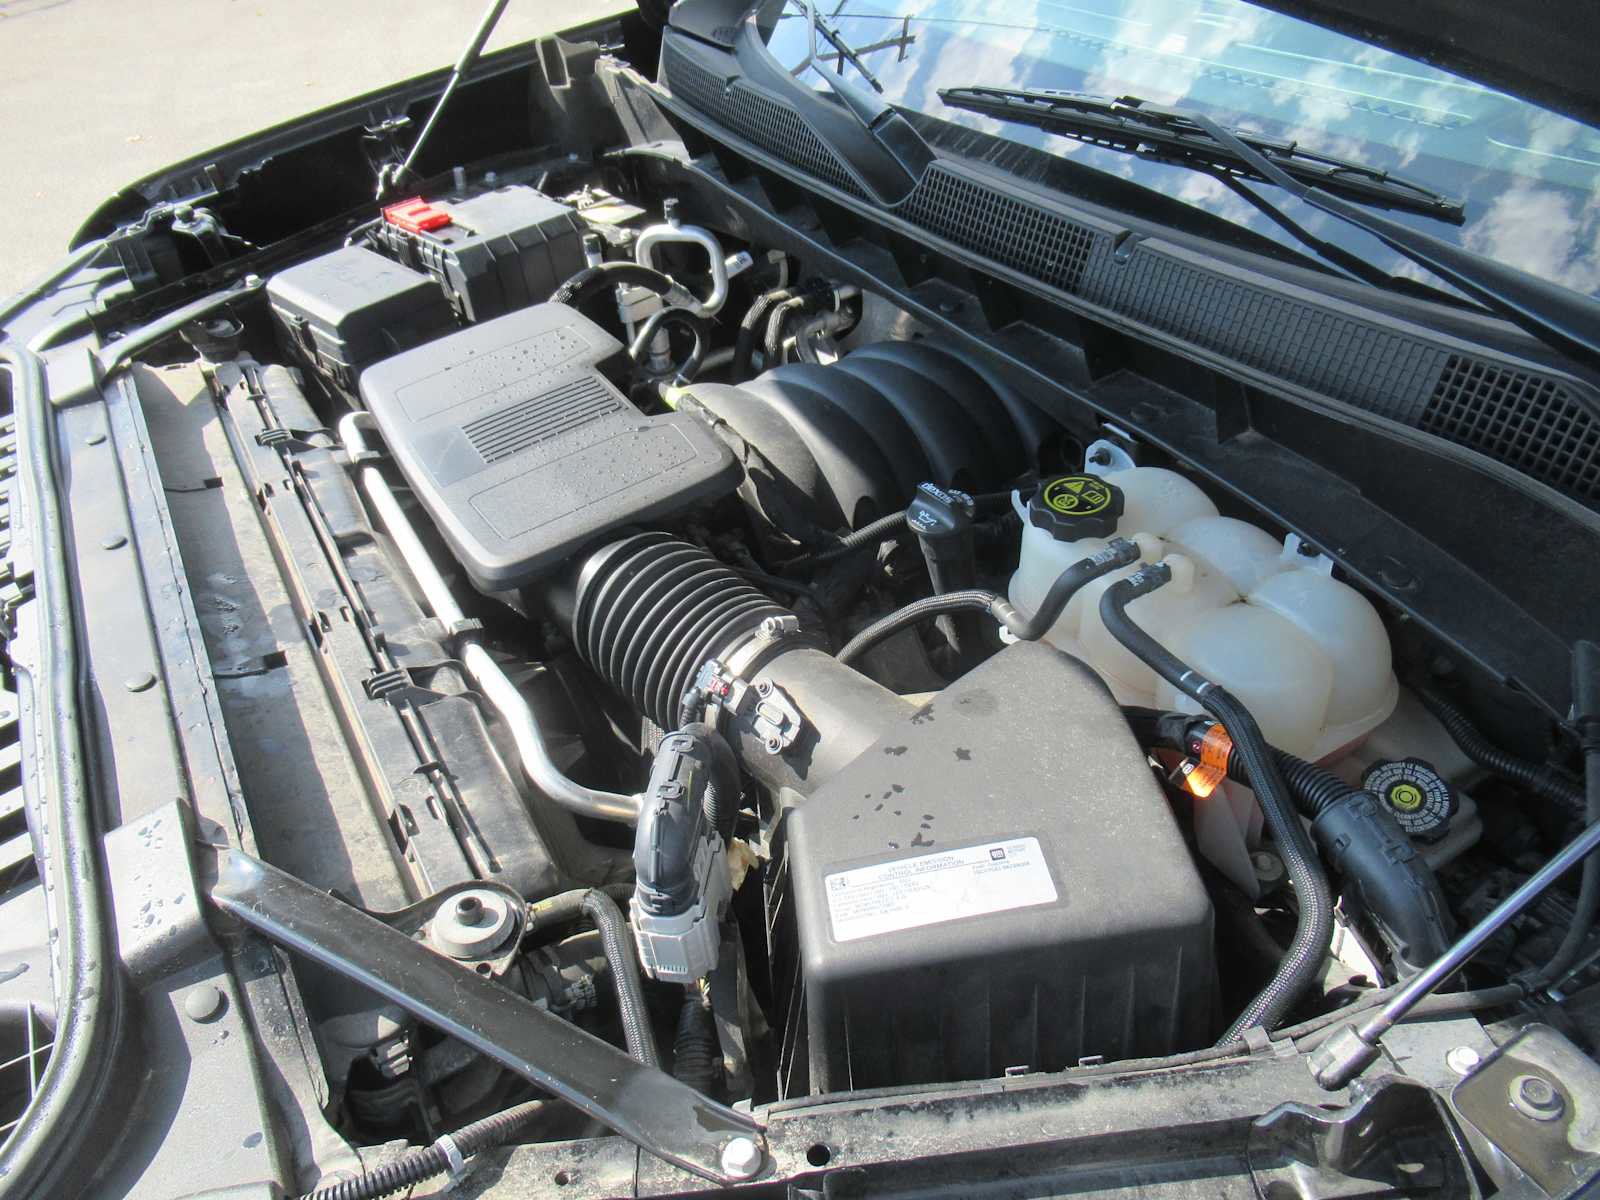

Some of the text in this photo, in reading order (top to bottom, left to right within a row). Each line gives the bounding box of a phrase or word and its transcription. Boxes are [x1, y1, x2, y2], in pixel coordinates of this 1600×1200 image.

[878, 870, 913, 881] CONTROL
[914, 860, 965, 876] INFORMATION
[887, 855, 955, 873] VEHICLE EMISSION
